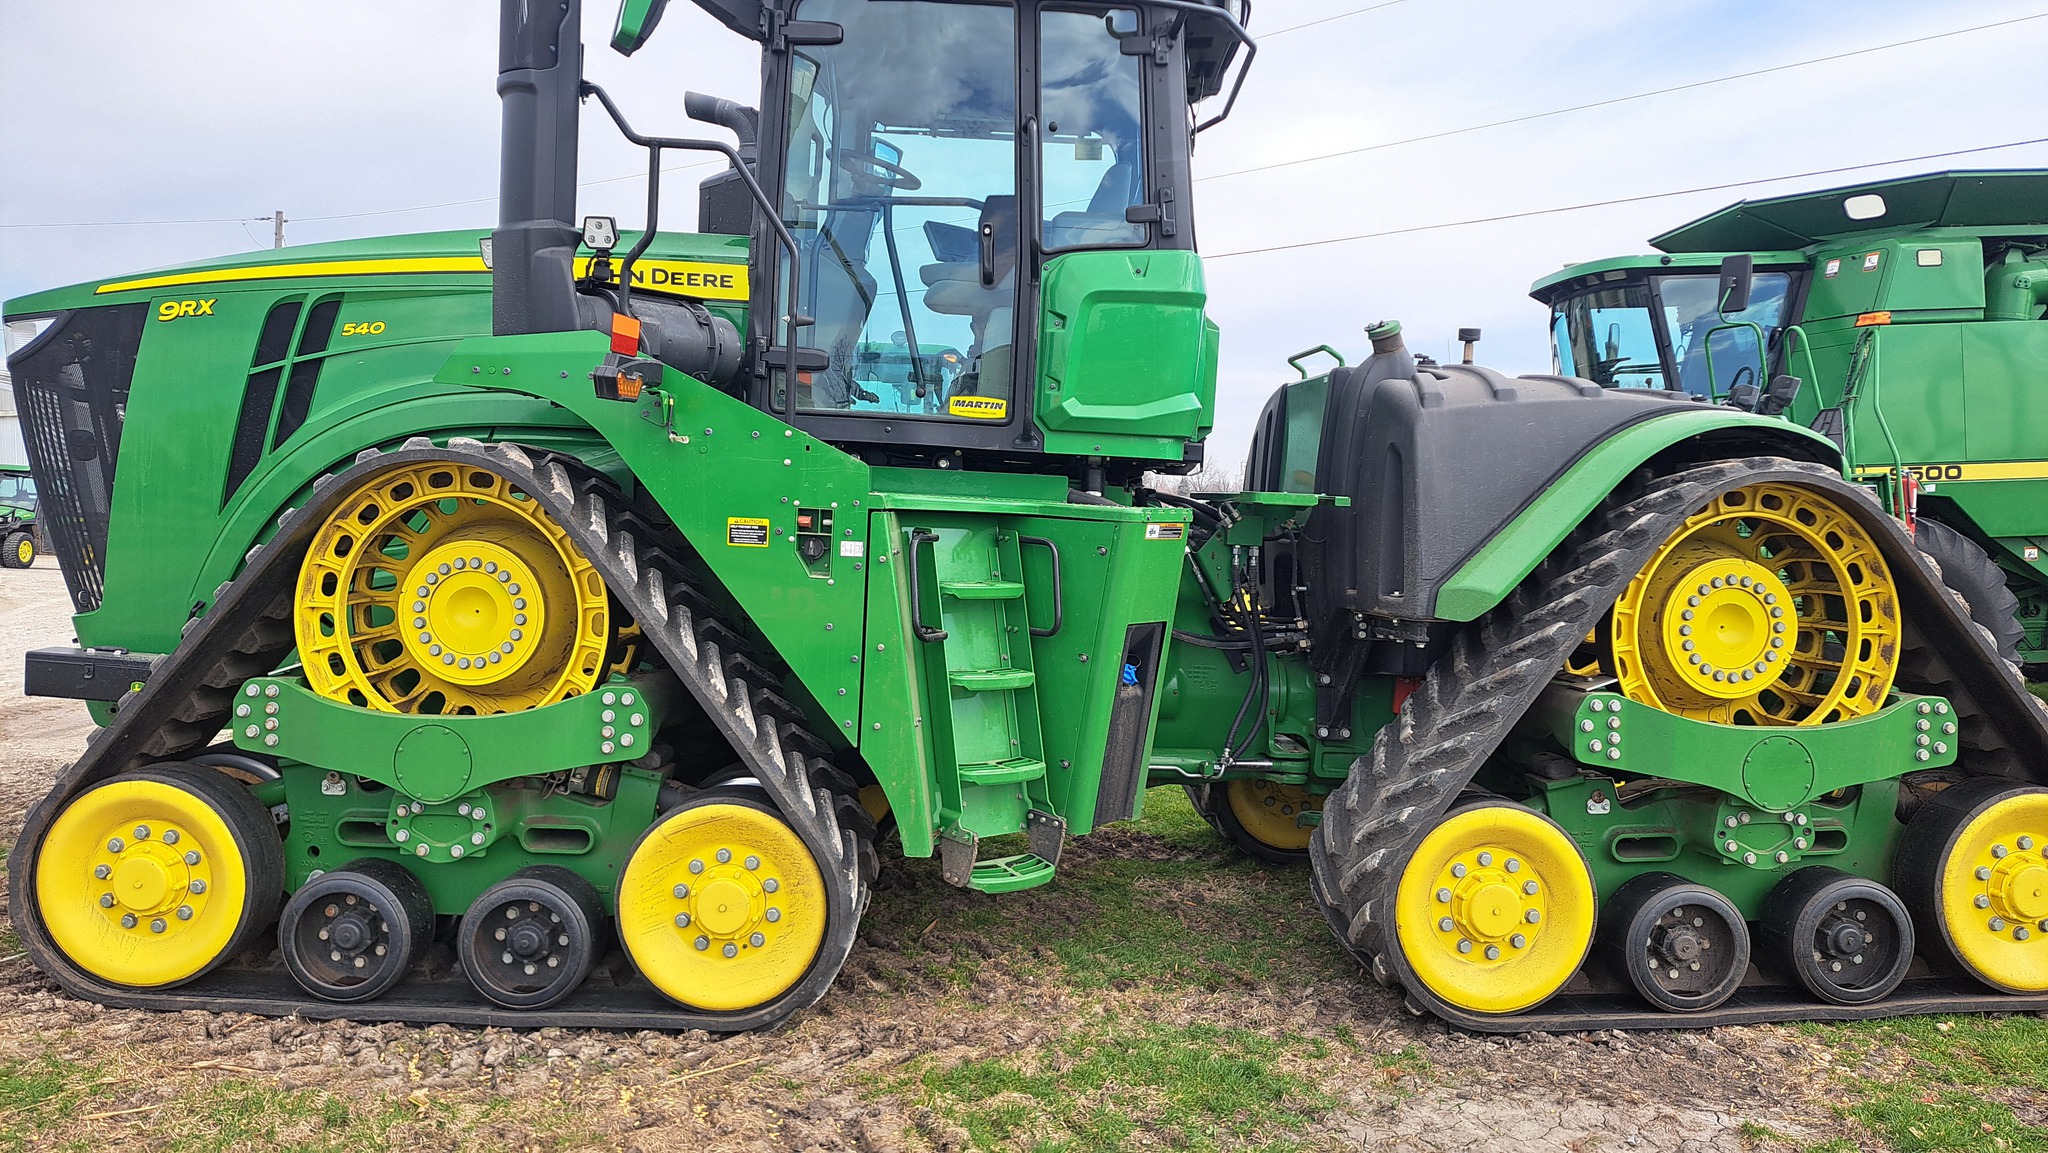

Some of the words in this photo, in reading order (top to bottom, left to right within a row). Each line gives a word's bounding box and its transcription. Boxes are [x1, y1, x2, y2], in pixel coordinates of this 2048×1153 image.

[651, 268, 734, 289] DEERE
[158, 298, 218, 323] 9RX
[341, 321, 387, 337] 540
[954, 399, 1004, 411] MARTIN
